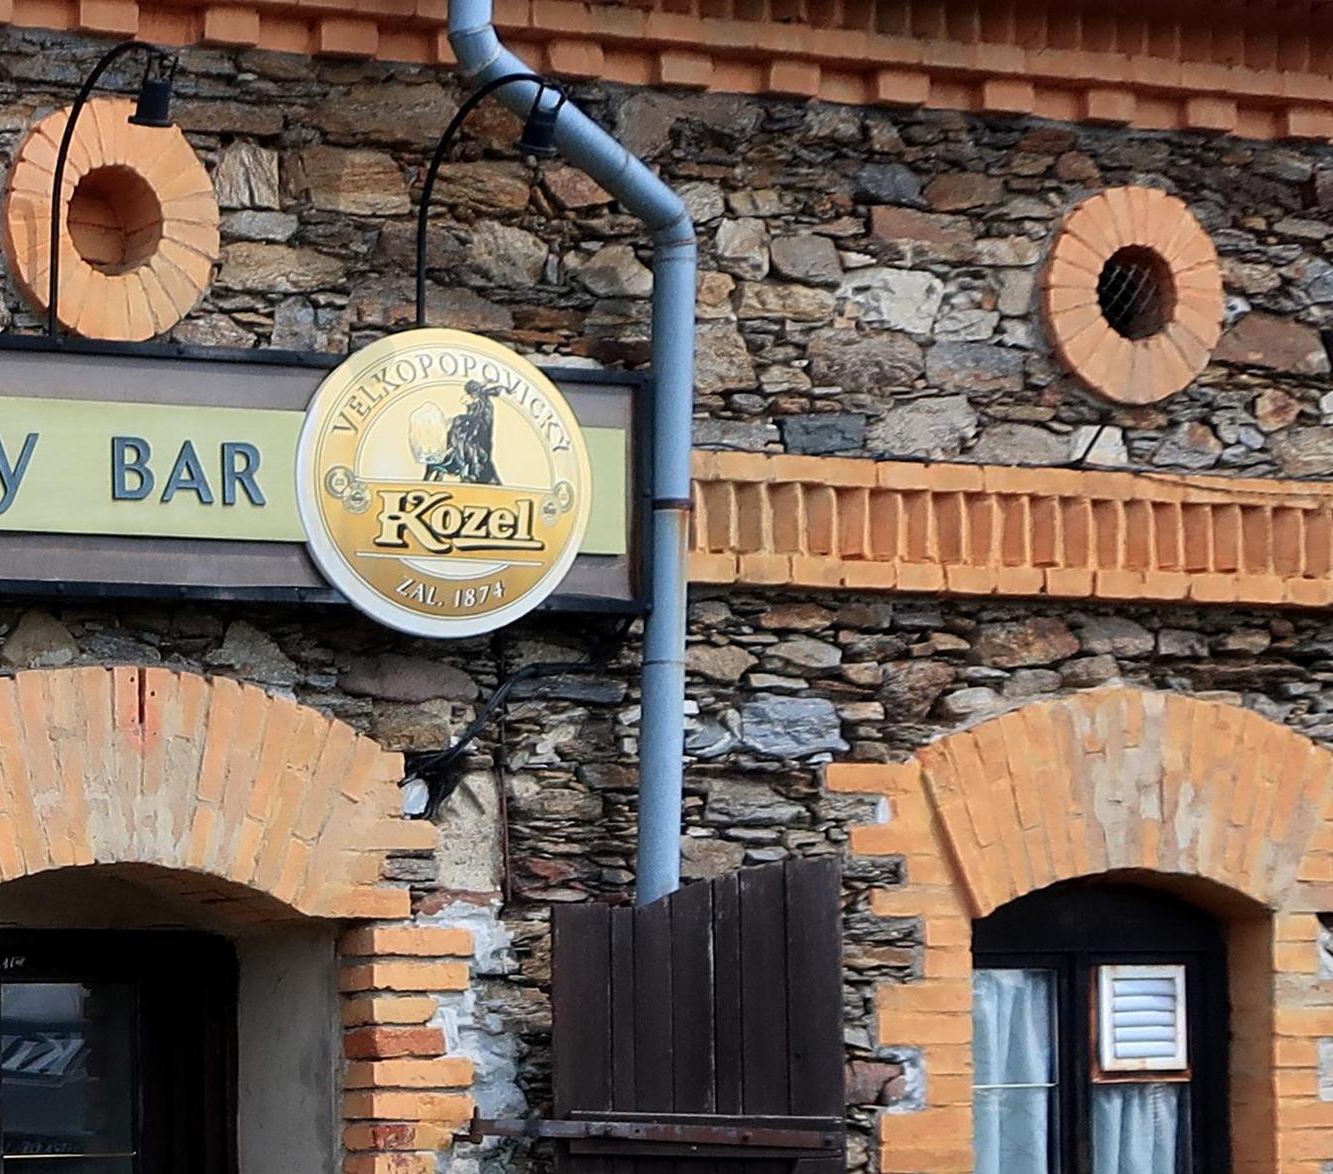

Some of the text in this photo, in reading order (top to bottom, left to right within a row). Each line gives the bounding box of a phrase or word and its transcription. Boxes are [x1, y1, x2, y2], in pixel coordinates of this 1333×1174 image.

[112, 436, 267, 508] BAR
[374, 489, 545, 554] Kozel
[395, 577, 505, 608] ZAL. 1874
